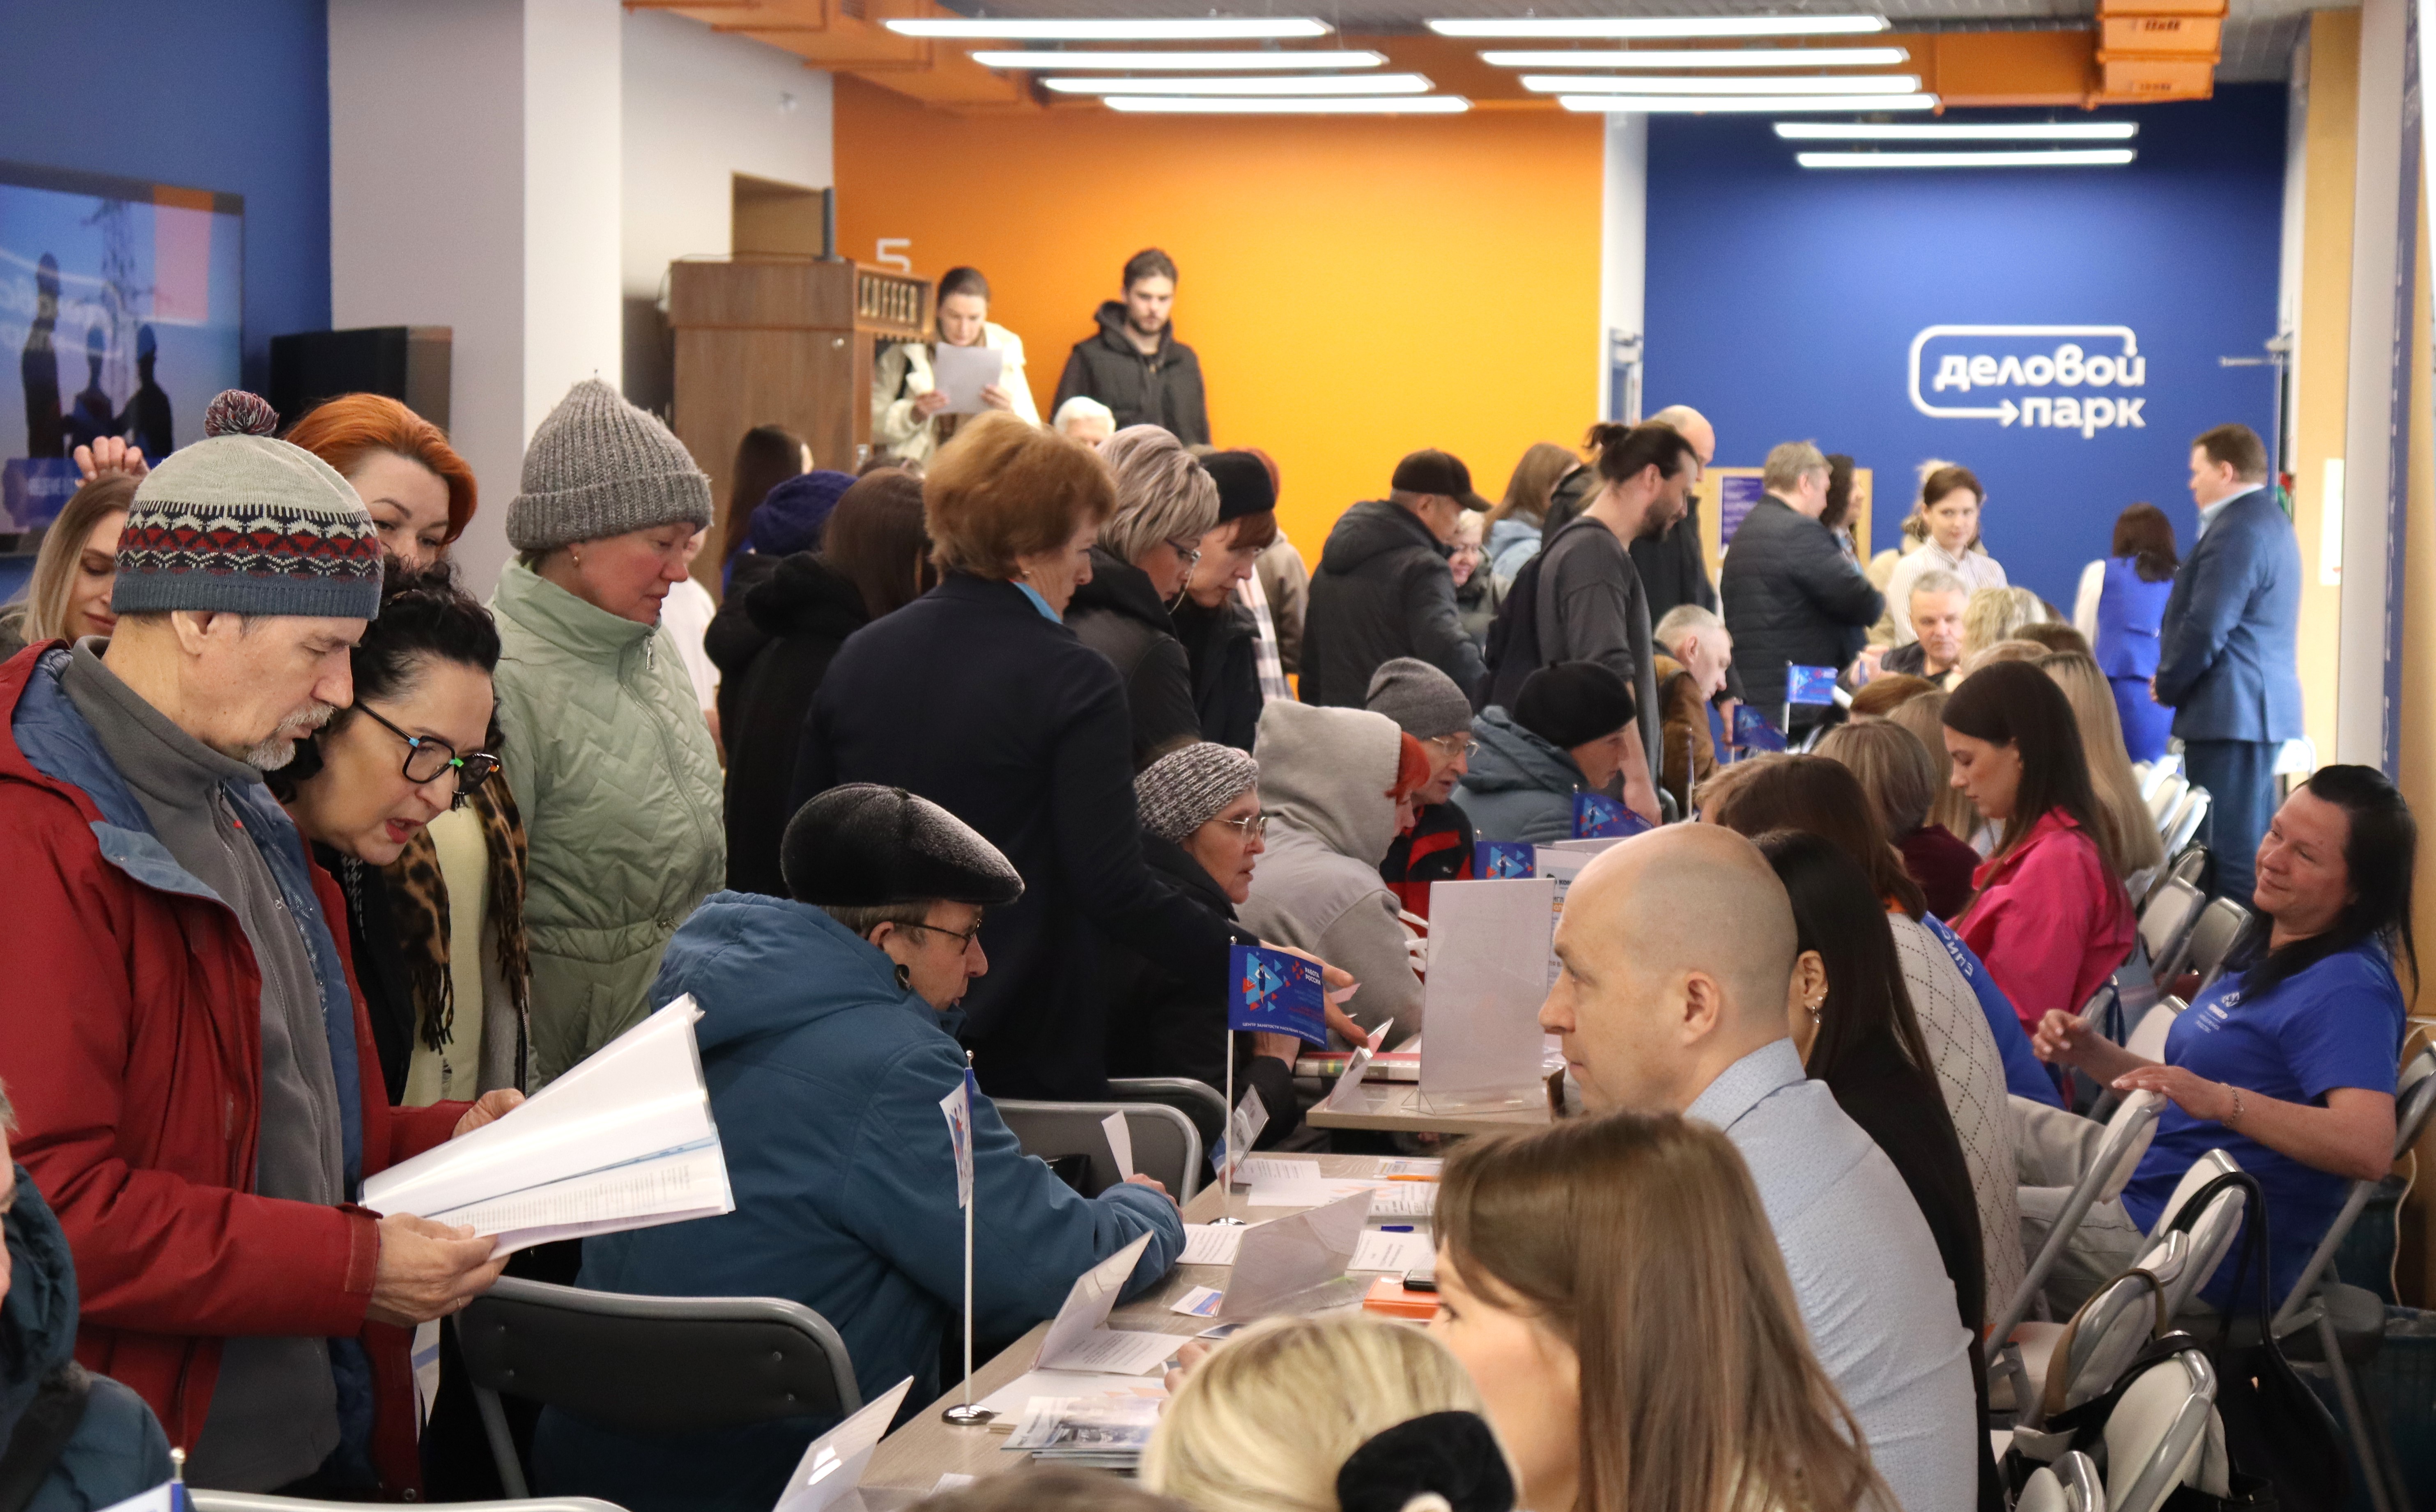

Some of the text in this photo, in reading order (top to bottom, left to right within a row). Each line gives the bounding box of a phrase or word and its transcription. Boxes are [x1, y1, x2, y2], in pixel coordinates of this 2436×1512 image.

[1933, 344, 2146, 392] деловой
[2020, 397, 2146, 439] парк
[1305, 966, 1320, 978] РАБОТА
[1305, 973, 1321, 985] РОССИИ
